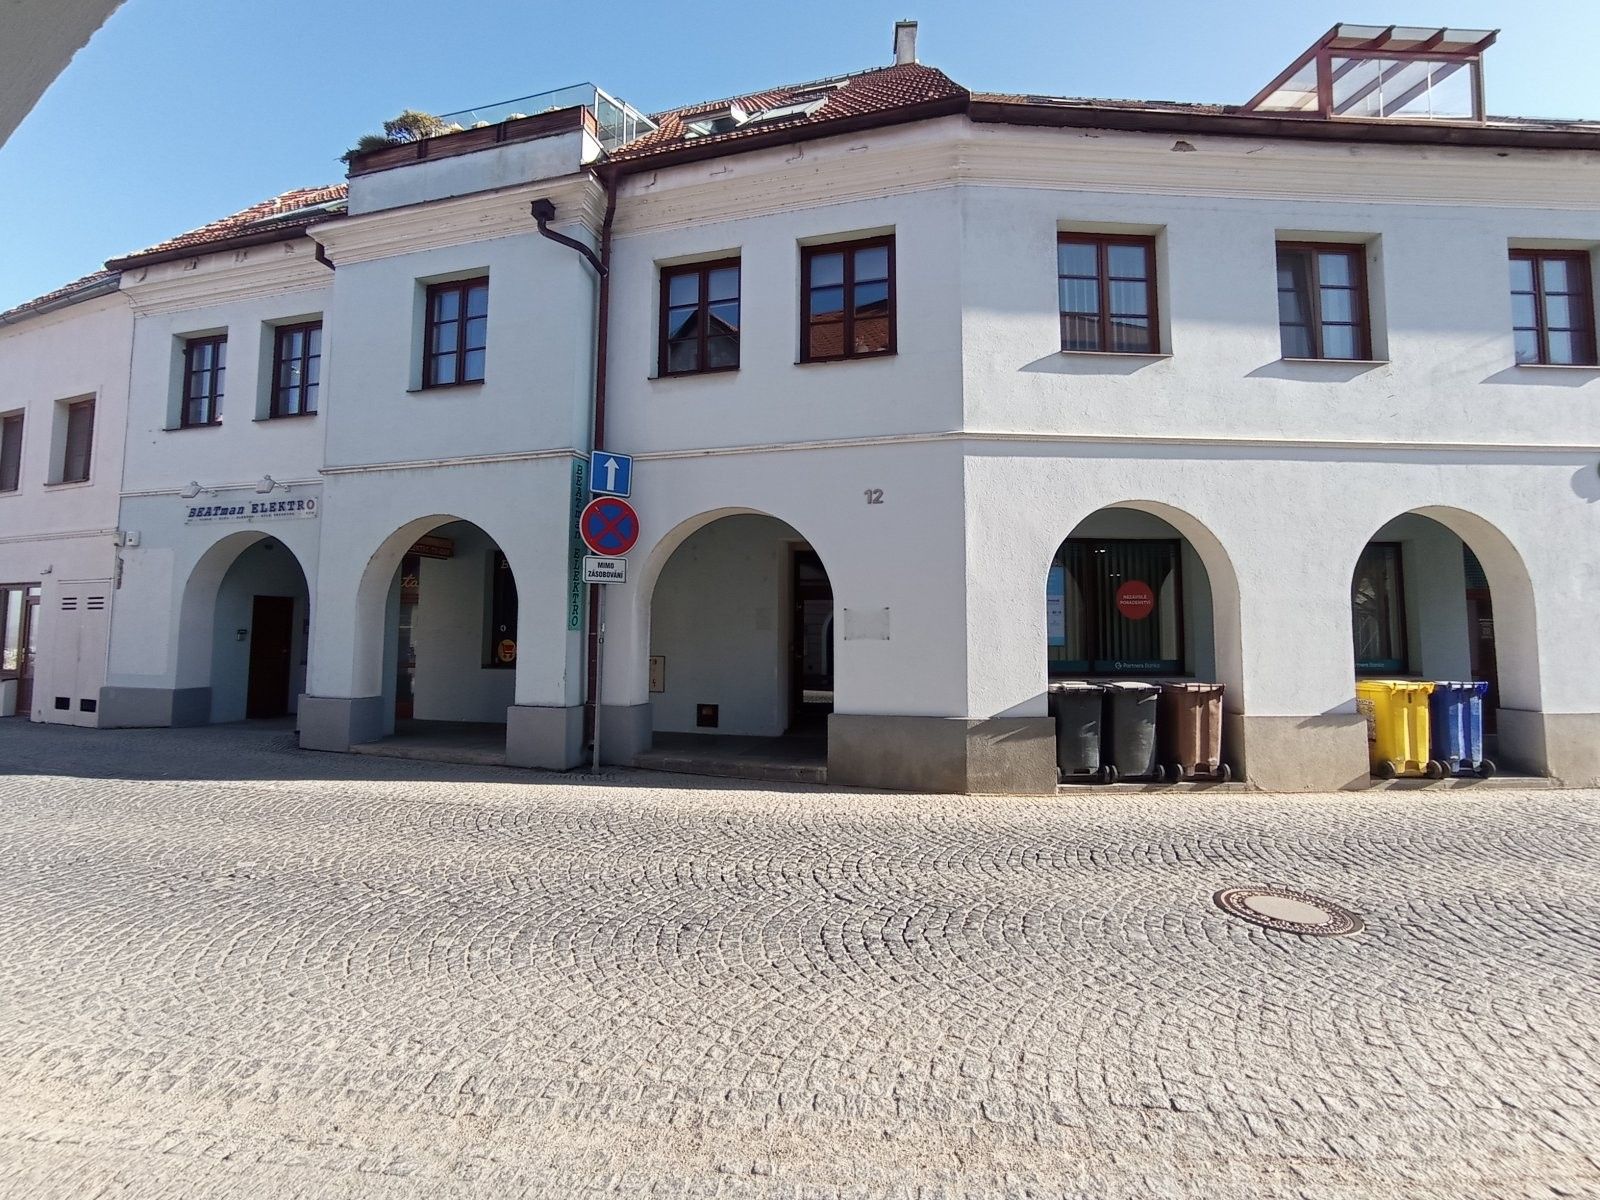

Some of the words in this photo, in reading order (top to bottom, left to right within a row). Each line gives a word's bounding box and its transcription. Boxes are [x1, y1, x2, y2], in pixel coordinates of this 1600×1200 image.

[863, 488, 884, 505] 12
[188, 505, 245, 518] BEATman
[250, 499, 316, 514] ELEKTRO
[587, 569, 624, 579] ZÁSOBOVÁNÍ
[571, 548, 581, 627] ELEKTRO
